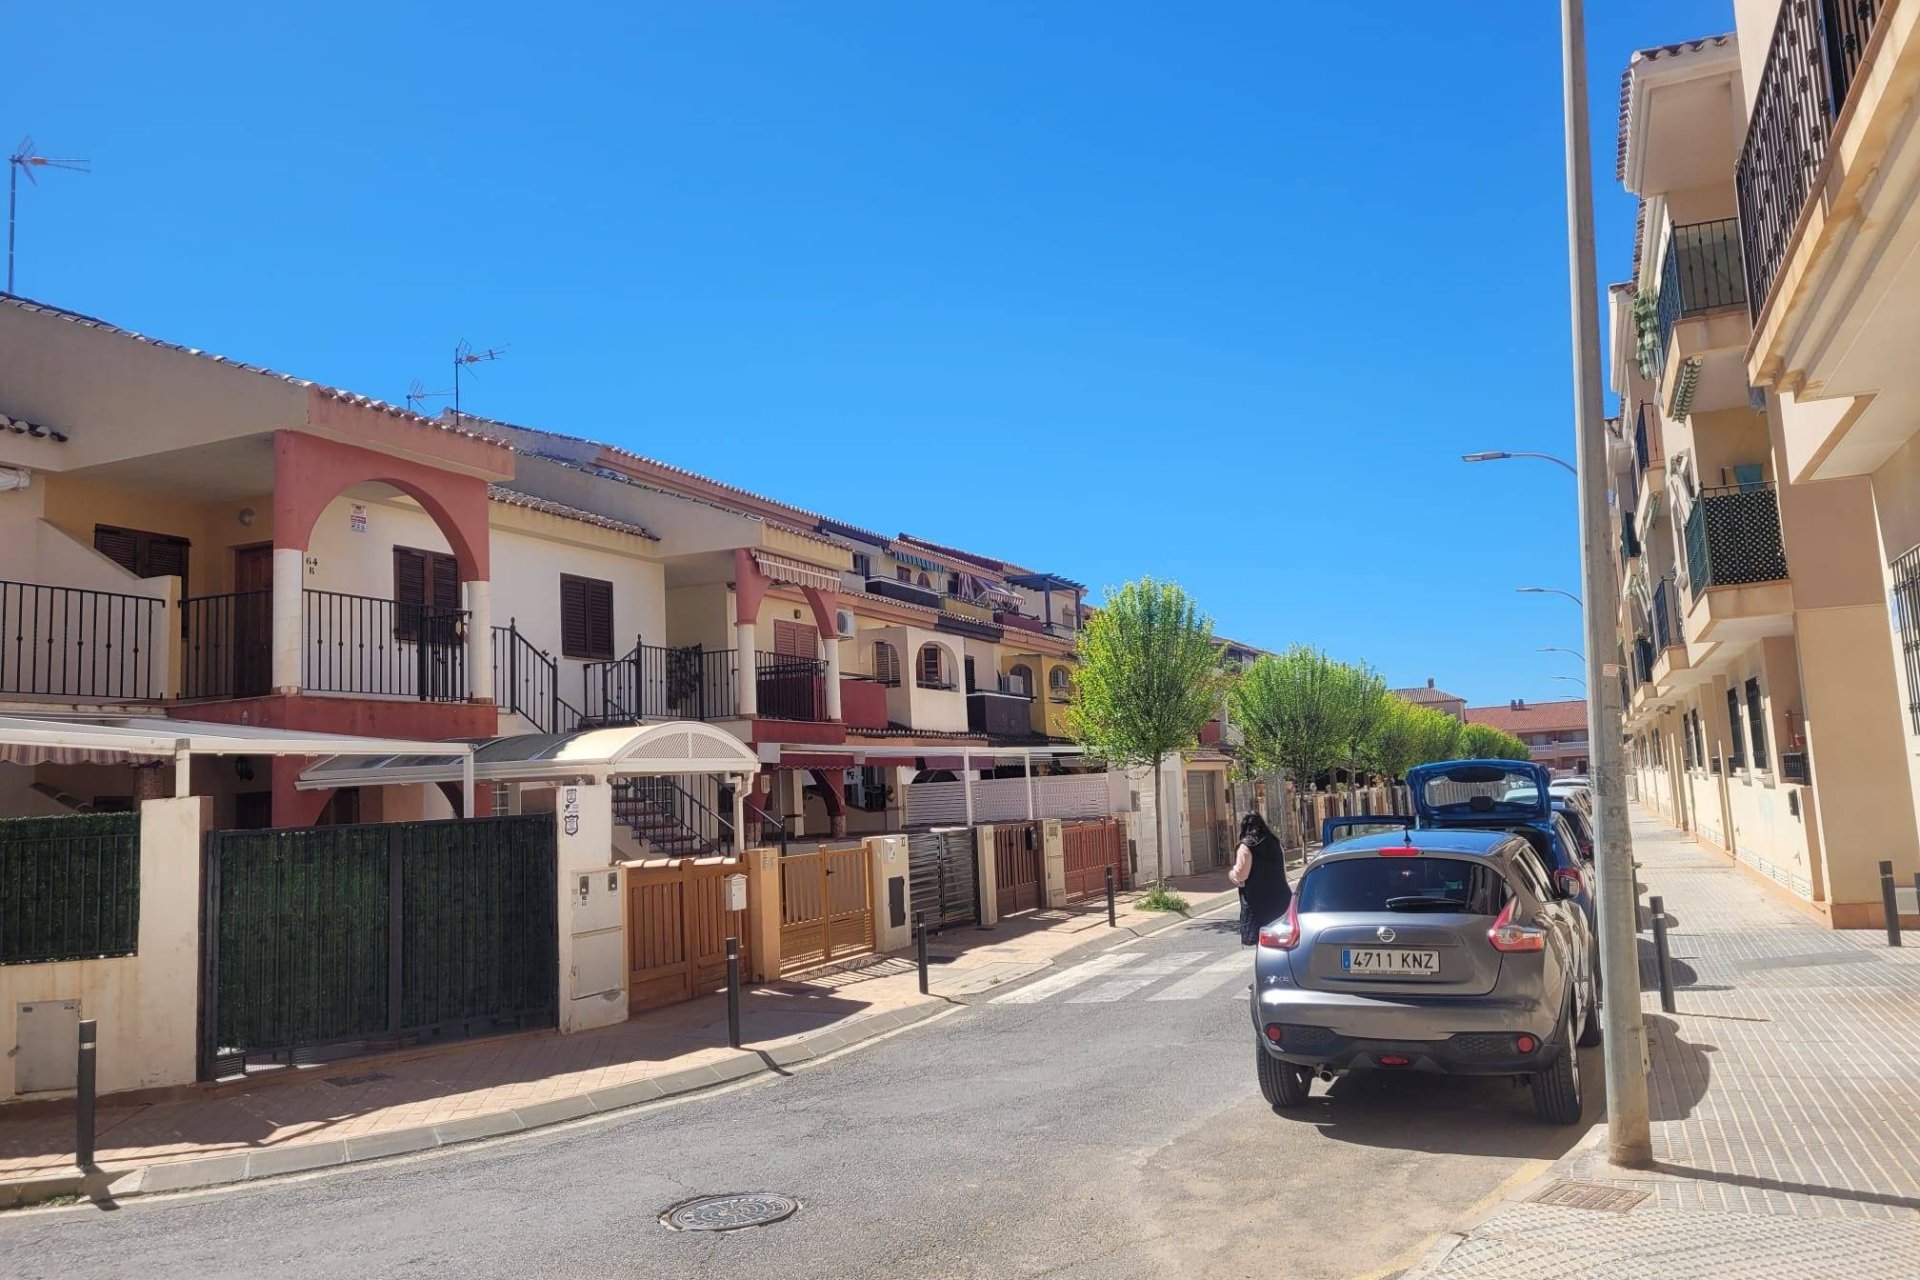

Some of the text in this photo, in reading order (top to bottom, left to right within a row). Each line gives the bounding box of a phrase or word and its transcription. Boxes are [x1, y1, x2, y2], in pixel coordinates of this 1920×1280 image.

[306, 557, 318, 566] 64
[1353, 952, 1434, 969] 4711 KNZ
